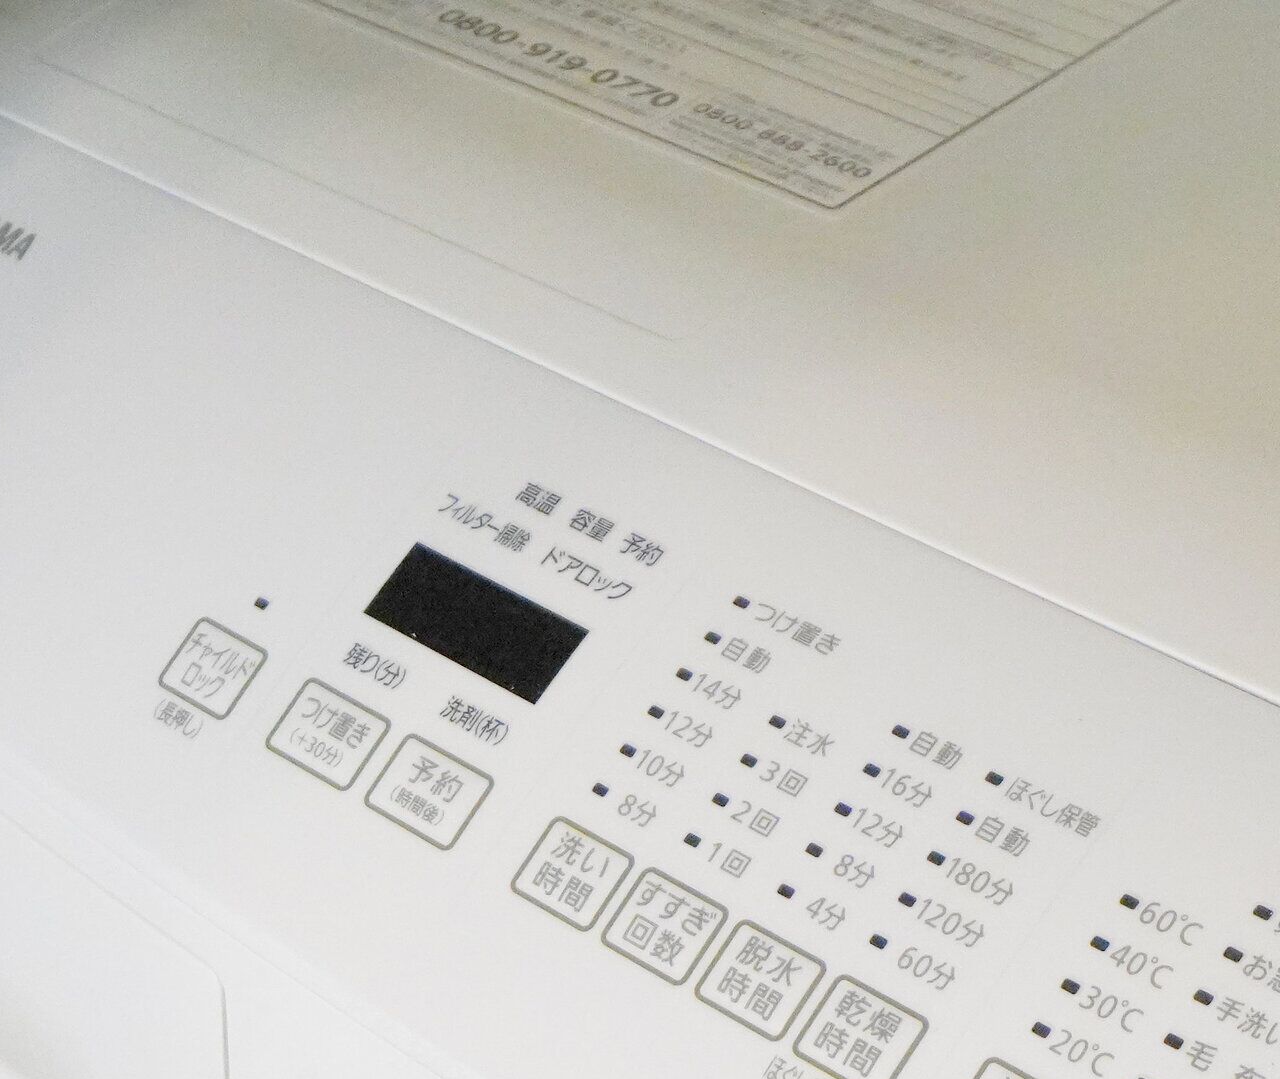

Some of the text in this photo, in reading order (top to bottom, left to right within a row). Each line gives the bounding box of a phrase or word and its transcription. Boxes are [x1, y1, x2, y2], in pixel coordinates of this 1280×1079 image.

[438, 9, 680, 107] 0800-919-0770
[438, 493, 632, 600] フィルター掃除 ドアロック
[515, 482, 665, 568] 高温 容量 予約
[754, 603, 844, 656] つけ置き
[184, 633, 257, 680] チャイルド
[343, 641, 407, 691] 残り(分)
[720, 637, 772, 674] 自動
[180, 662, 227, 700] ロック
[692, 673, 742, 710] 14分
[302, 697, 373, 750] つけ置き
[439, 694, 511, 746] 洗剤(杯)
[665, 711, 713, 749] 12分
[783, 717, 836, 757] 注水
[636, 749, 685, 788] 10分
[908, 731, 964, 770] 自動
[410, 755, 465, 803] 予約
[759, 761, 809, 797] 3回
[879, 768, 932, 809] 16分
[617, 794, 657, 828] 8分
[730, 800, 780, 838] 2回
[851, 807, 904, 848] 12分
[1003, 776, 1102, 838] ほぐし保管
[550, 830, 610, 879] 洗い
[974, 815, 1031, 857] 自動
[707, 842, 753, 879] 1回
[833, 854, 875, 889] 8分
[944, 857, 1014, 906] 180分
[532, 861, 595, 913] 時間
[636, 879, 719, 938] すすぎ
[806, 897, 847, 931] 4分
[916, 899, 985, 948] 120分
[623, 913, 686, 968] 回数
[736, 935, 803, 988] 脱水
[897, 946, 957, 992] 60分
[717, 967, 784, 1022] 時間
[834, 989, 903, 1045] 乾燥
[814, 1022, 883, 1079] 時間
